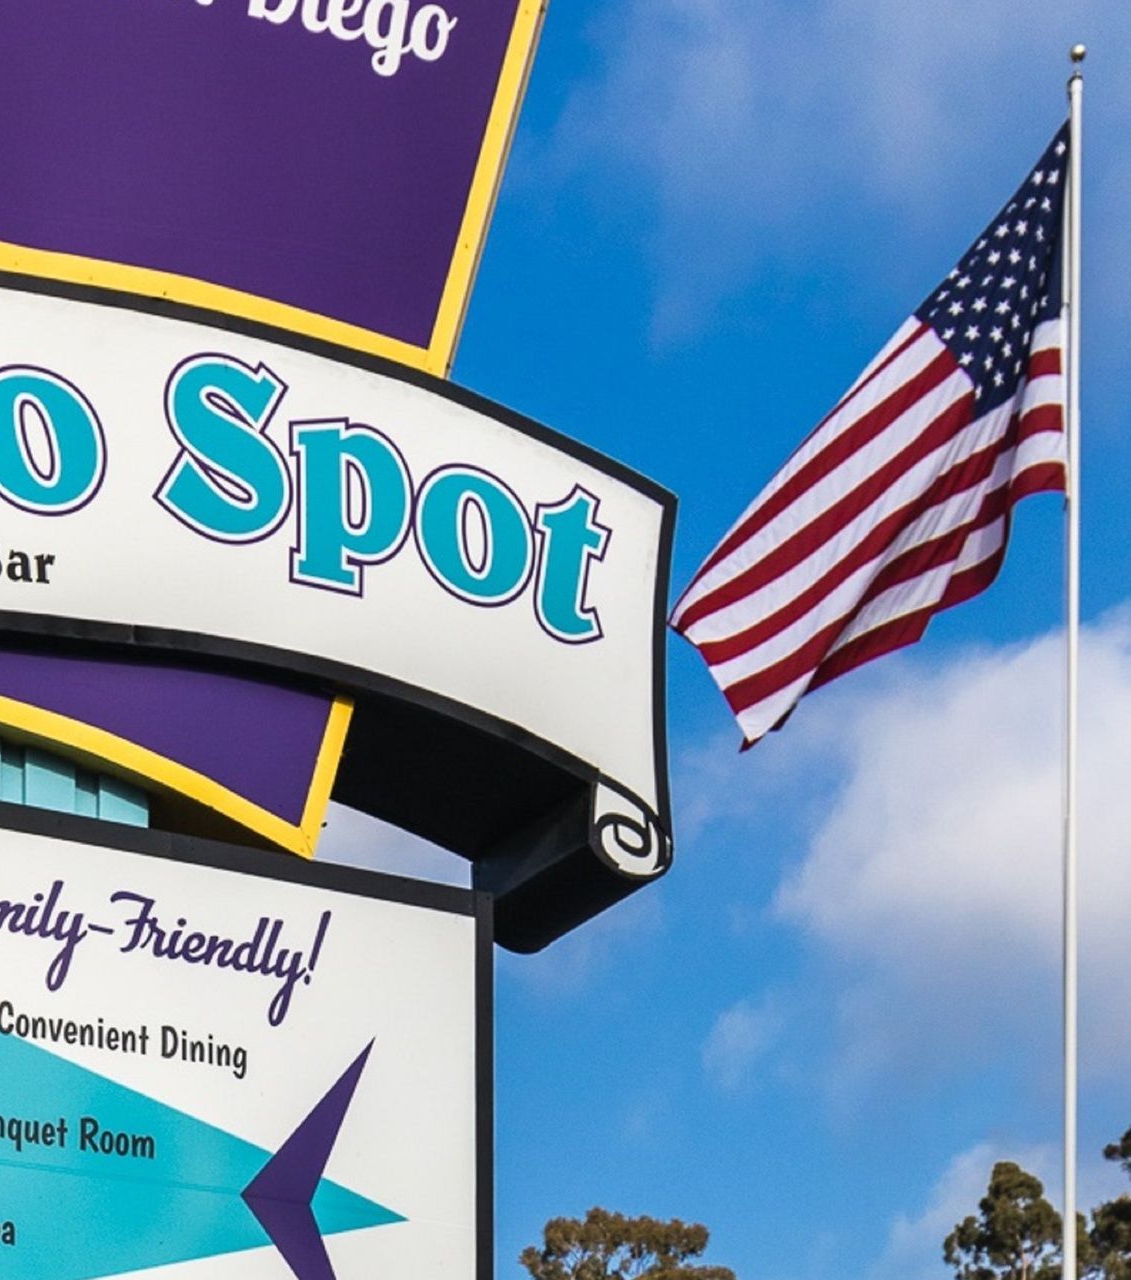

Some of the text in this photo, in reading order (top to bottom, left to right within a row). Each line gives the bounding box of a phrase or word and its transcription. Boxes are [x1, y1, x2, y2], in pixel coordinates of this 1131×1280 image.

[155, 352, 612, 644] Spot
[160, 1025, 248, 1080] Dining
[79, 1117, 156, 1160] Room
